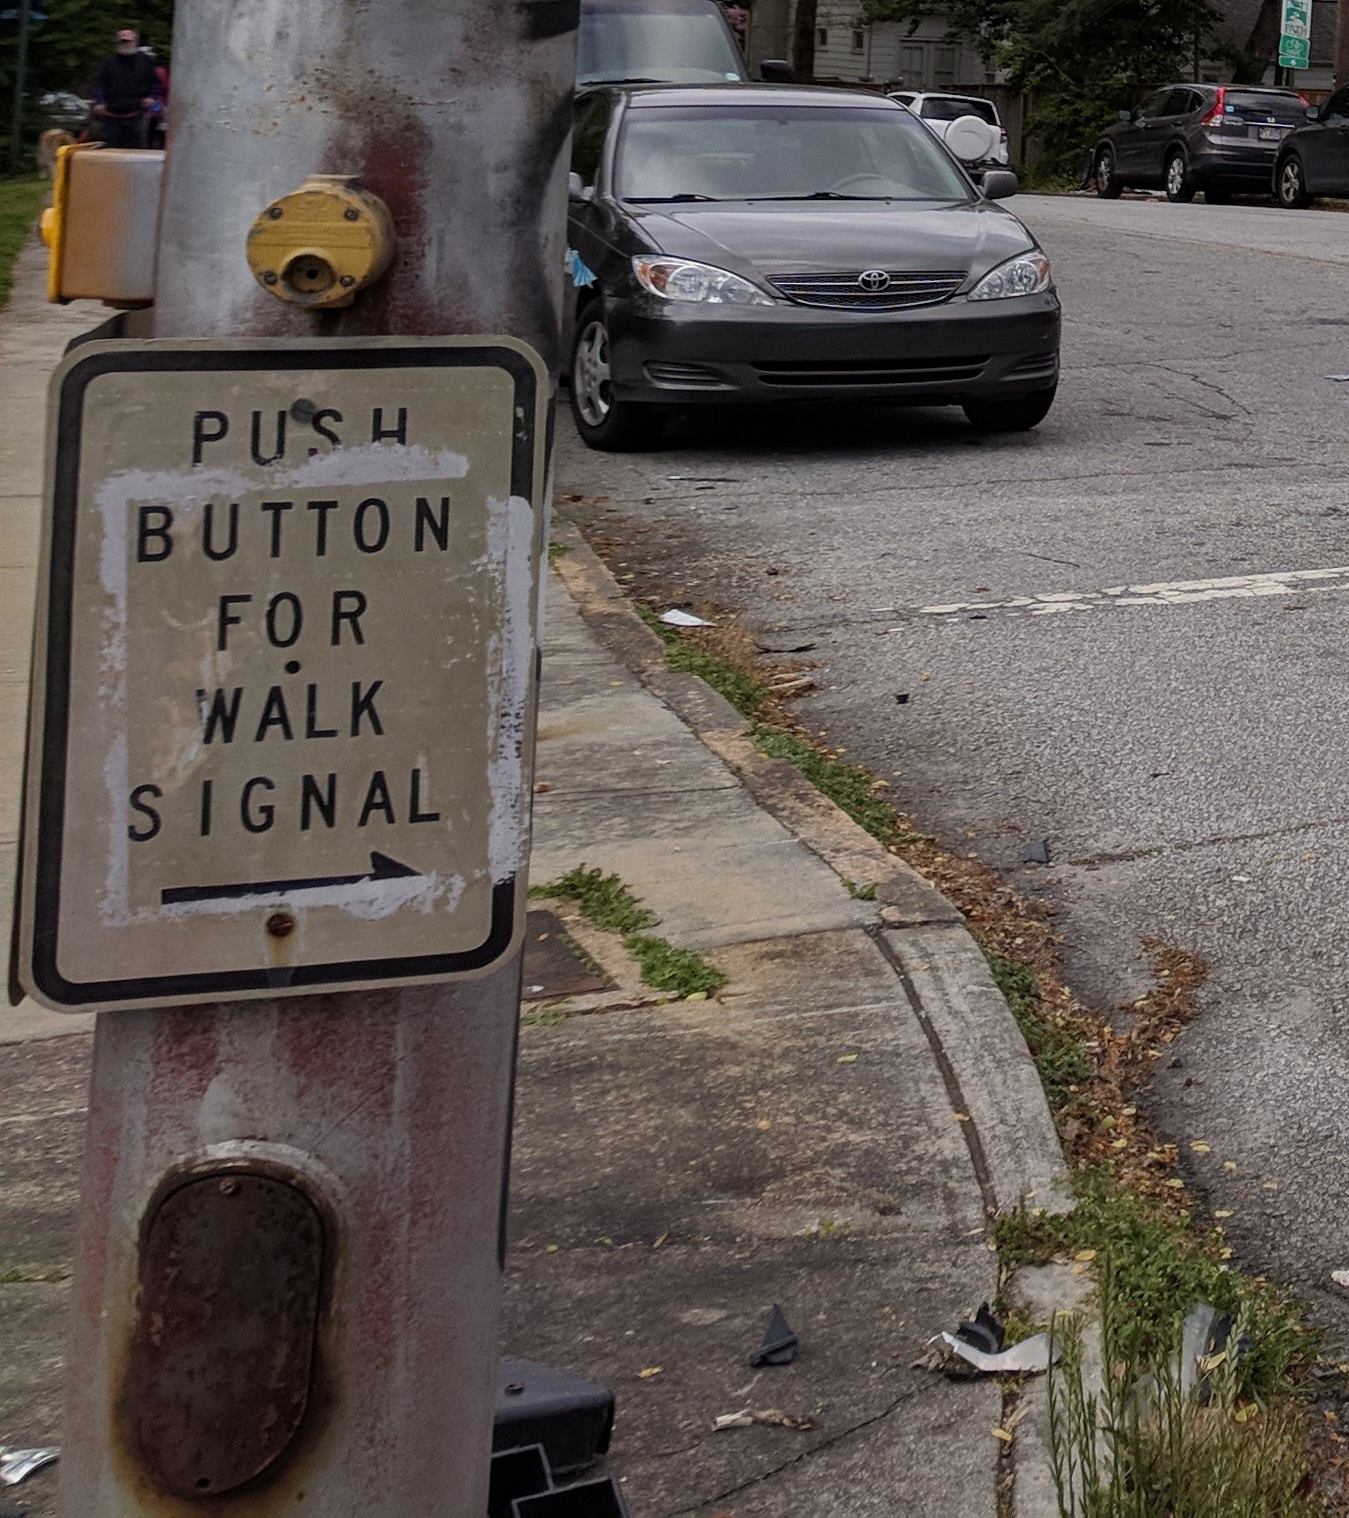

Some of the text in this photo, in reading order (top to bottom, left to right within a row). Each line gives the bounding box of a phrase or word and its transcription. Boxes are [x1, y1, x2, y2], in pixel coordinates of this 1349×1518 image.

[192, 406, 409, 468] PUSH
[136, 496, 451, 563] BUTTON
[216, 589, 368, 652] FOR
[196, 679, 386, 746] WALK
[127, 767, 442, 843] SIGNAL
